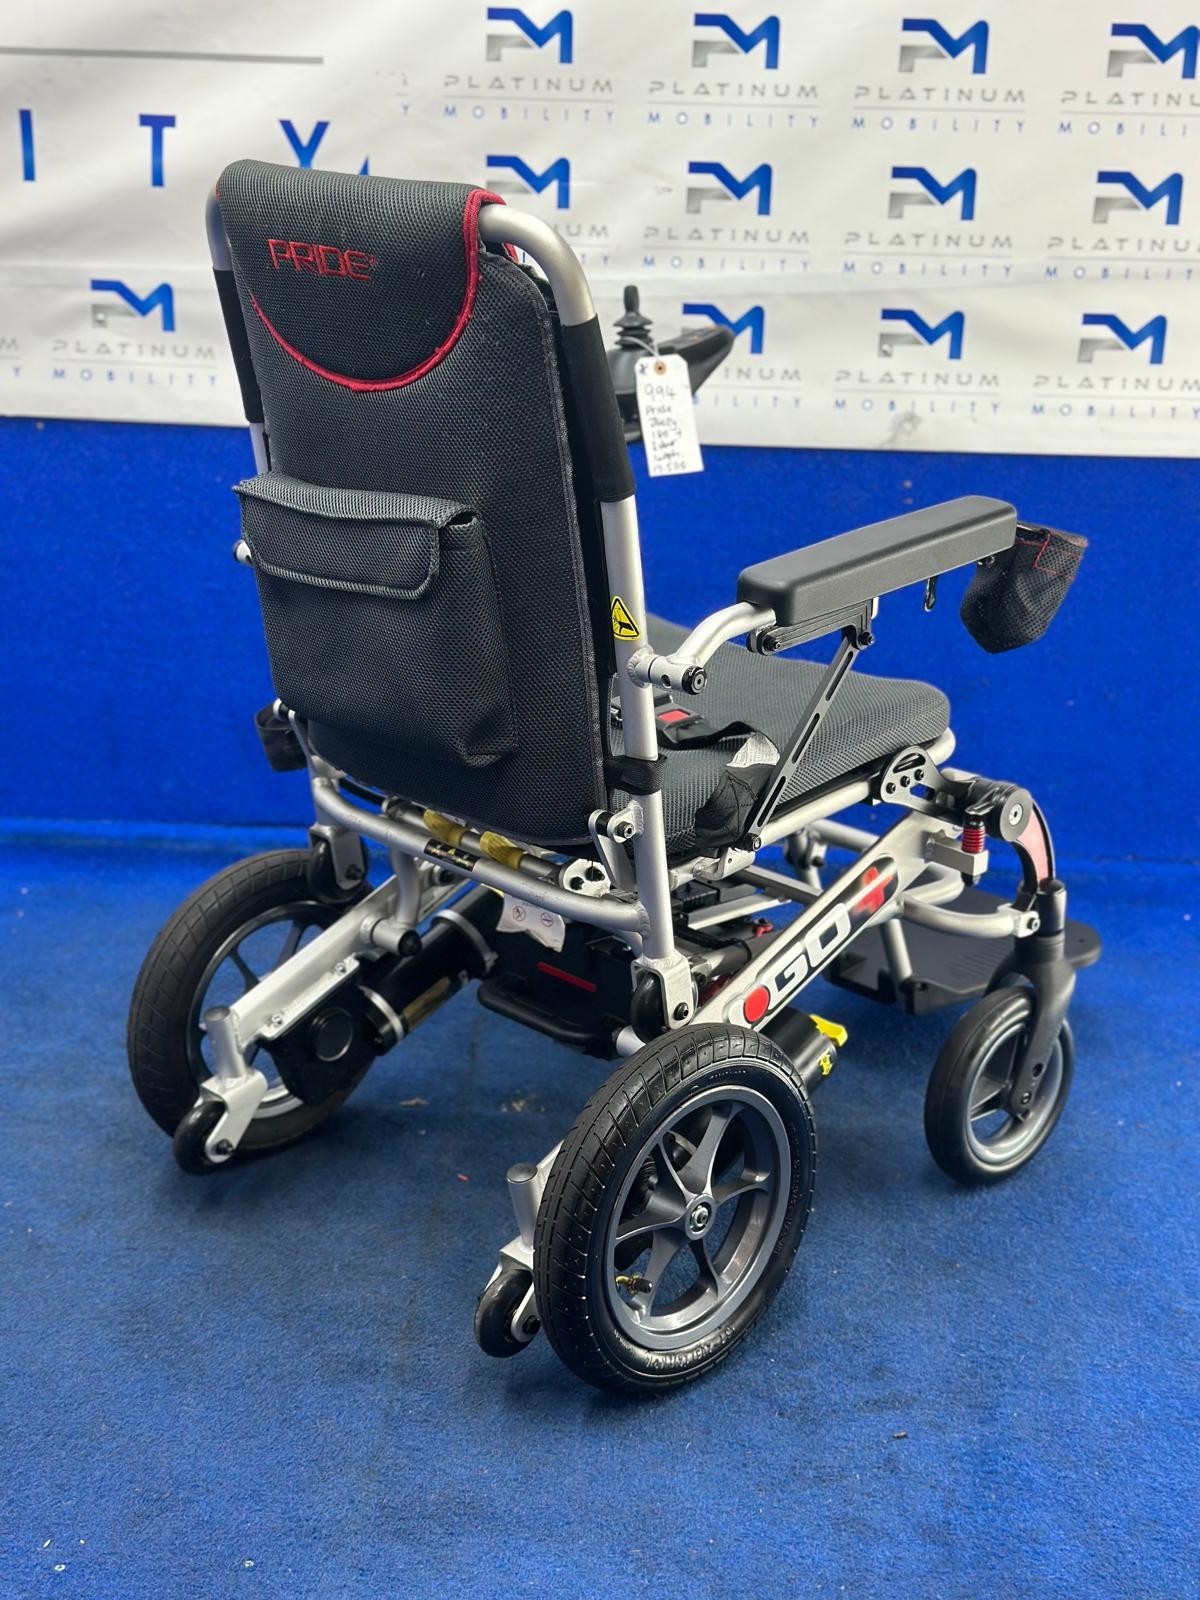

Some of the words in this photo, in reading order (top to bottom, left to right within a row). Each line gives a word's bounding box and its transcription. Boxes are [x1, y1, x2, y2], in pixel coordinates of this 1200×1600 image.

[443, 75, 613, 93] PLATINUM
[649, 81, 819, 99] PLATINUM
[854, 86, 1026, 103] PLATINUM
[443, 105, 614, 122] MOBILITY
[648, 112, 818, 128] MOBILITY
[852, 117, 1025, 133] MOBILITY
[1059, 121, 1189, 136] MOBILI
[643, 227, 810, 244] PLATINUM
[844, 232, 1013, 249] PLATINUM
[1047, 236, 1200, 253] PLATINU
[642, 256, 810, 271] MOBILITY
[843, 261, 1012, 277] MOBILITY
[1045, 266, 1194, 280] MOBILIT
[52, 339, 216, 359] PLATINUM
[53, 367, 217, 385] MOBILITY
[834, 370, 1000, 387] PLATINUM
[1033, 375, 1200, 391] PLATINUM
[644, 384, 677, 402] 994
[833, 398, 1000, 413] MOBILITY
[1031, 404, 1200, 420] MOBILITY
